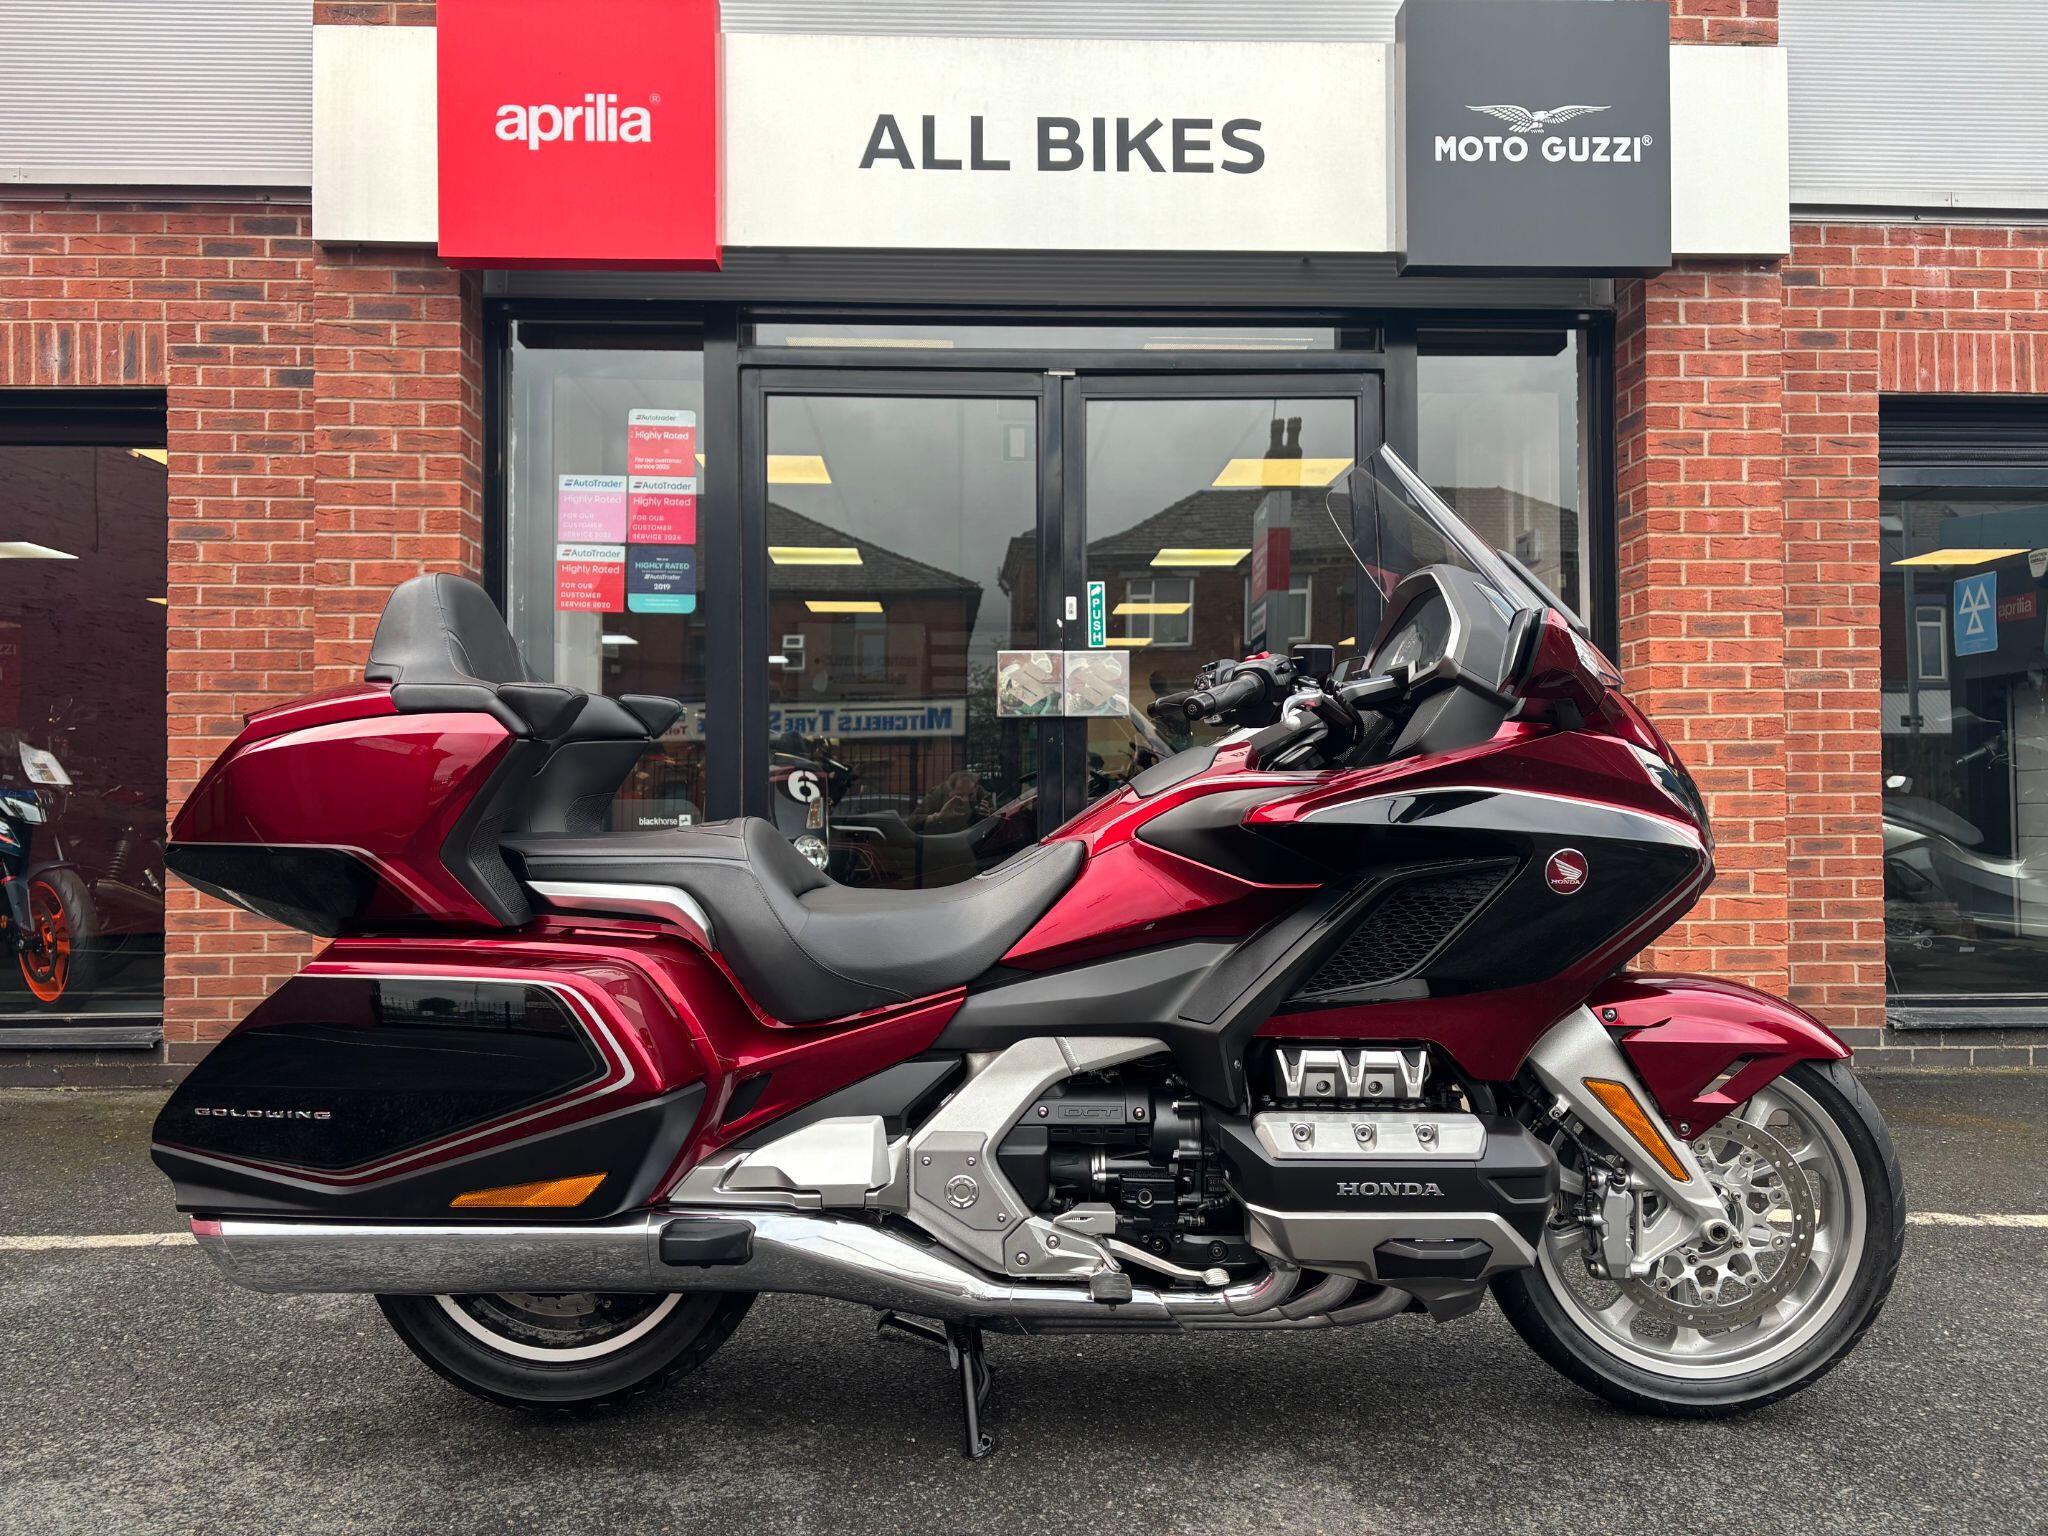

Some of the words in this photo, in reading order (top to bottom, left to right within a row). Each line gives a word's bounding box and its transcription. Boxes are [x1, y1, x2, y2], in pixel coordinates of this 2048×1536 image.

[858, 113, 1011, 171] ALL
[1037, 116, 1266, 175] BIKES
[1434, 135, 1528, 162] MOTO
[635, 431, 662, 440] Highly
[663, 431, 689, 440] Rated
[573, 479, 624, 488] AutoTrader
[642, 481, 692, 490] AutoTrader
[563, 495, 593, 505] Highly
[594, 495, 622, 504] Rated
[633, 496, 662, 508] Highly
[663, 497, 691, 506] Rated
[571, 549, 621, 558] AutoTrader
[561, 564, 591, 575] Highly
[592, 564, 620, 574] Rated
[664, 562, 690, 570] RATED
[560, 591, 602, 599] CUSTOMER
[1092, 598, 1102, 642] PUSH
[787, 770, 821, 803] 6
[638, 816, 678, 826] blackhorse
[1063, 1107, 1119, 1117] DCT
[1336, 1182, 1445, 1196] HONDA
